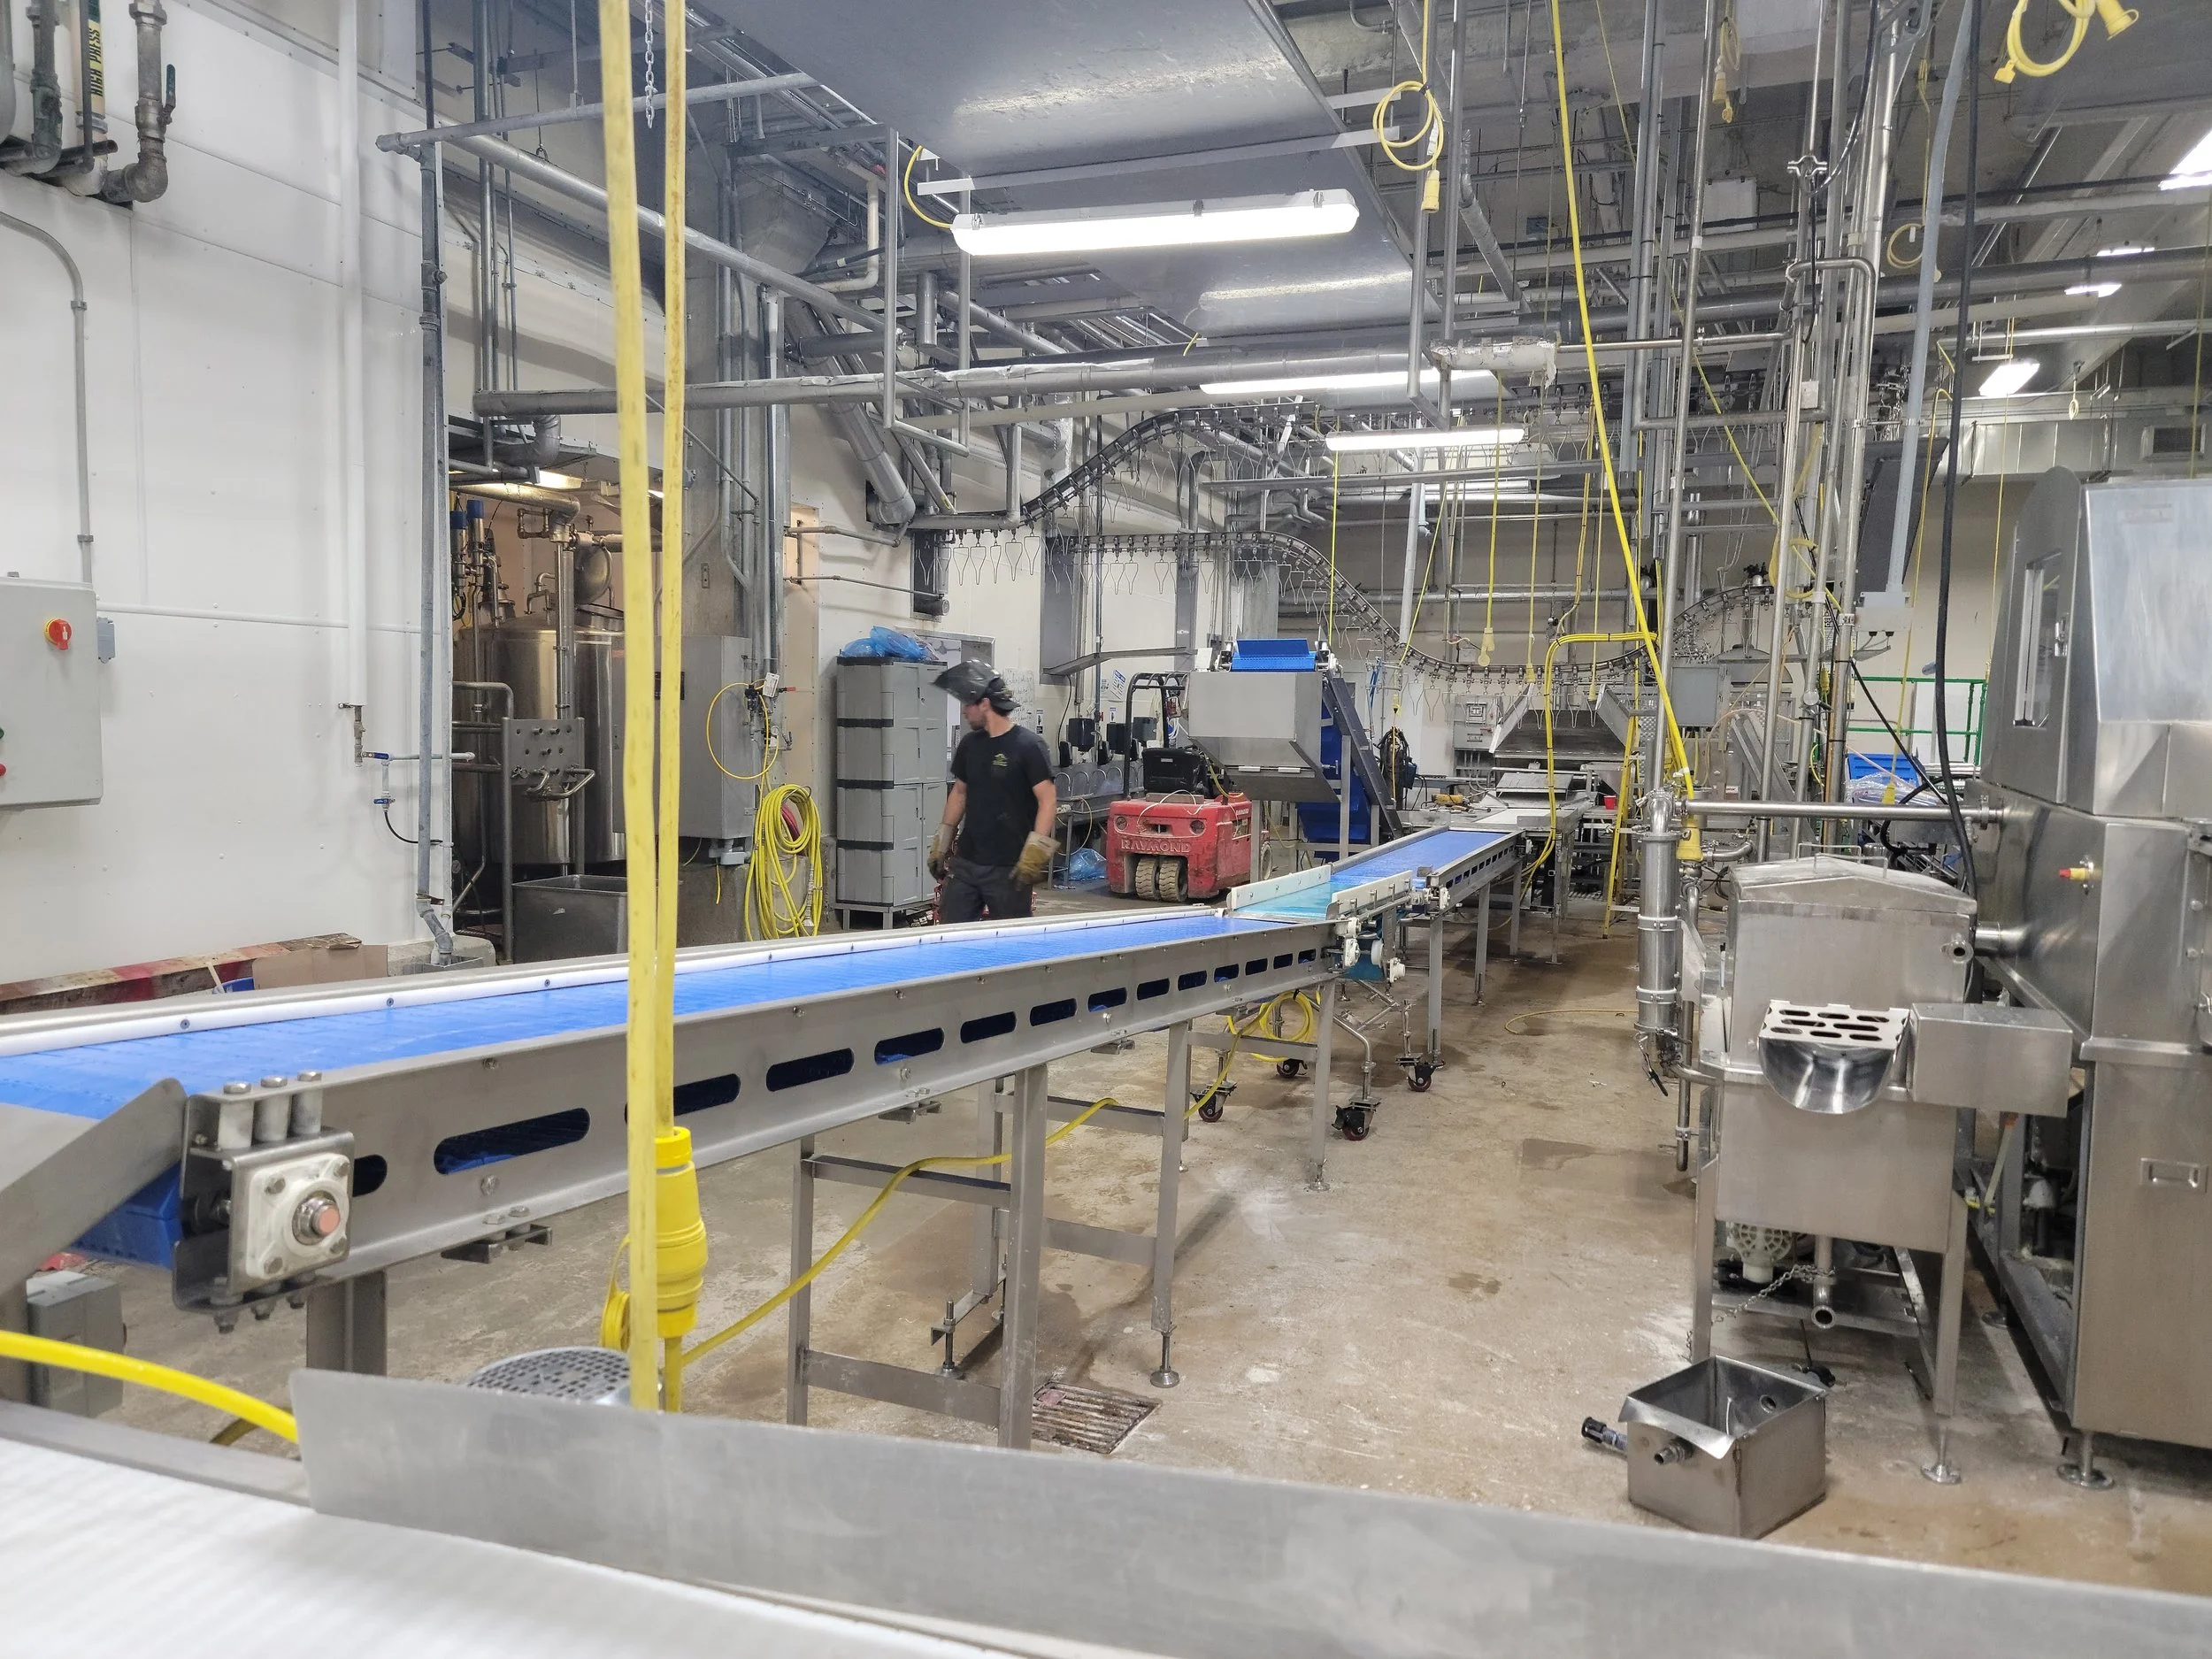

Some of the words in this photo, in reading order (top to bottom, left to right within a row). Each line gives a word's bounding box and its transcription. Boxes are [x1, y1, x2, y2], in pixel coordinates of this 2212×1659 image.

[88, 27, 102, 64] PRESS
[90, 68, 103, 96] HIGH
[1120, 838, 1191, 853] RAYMOND
